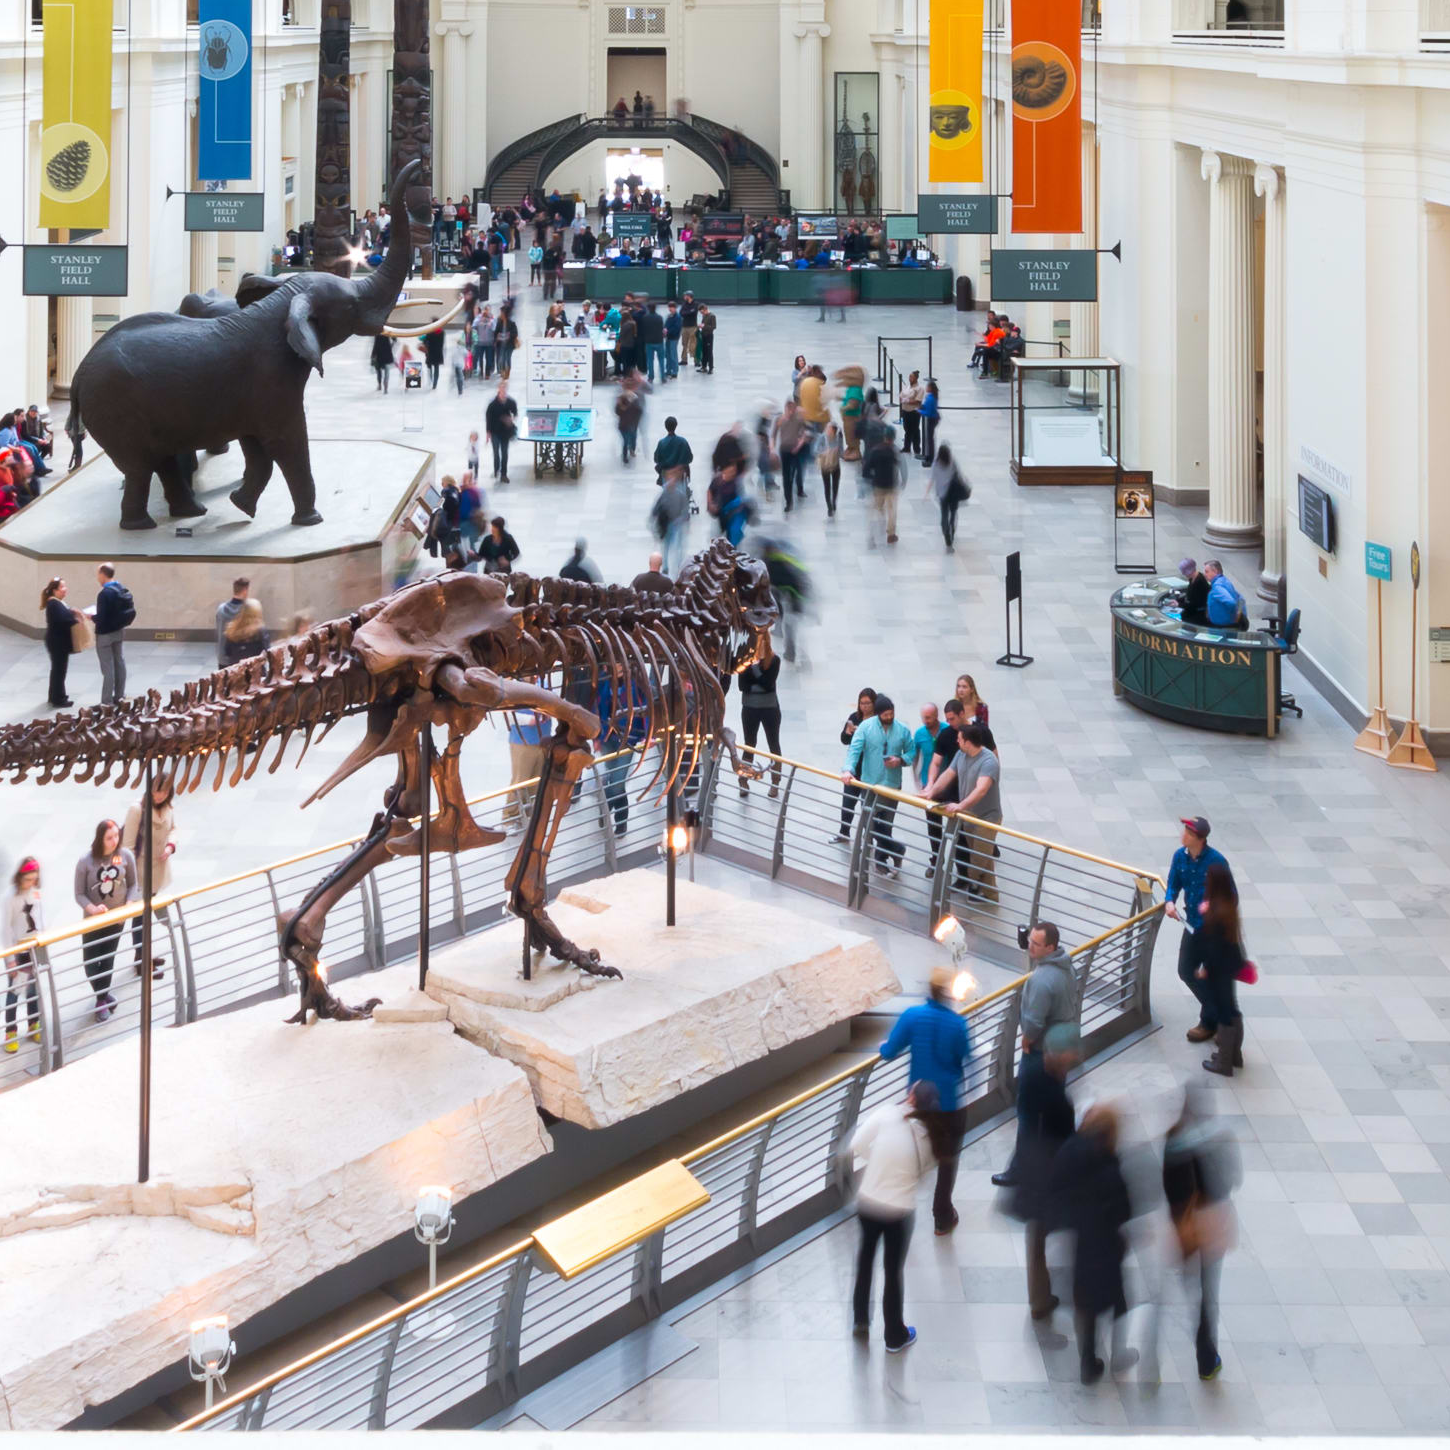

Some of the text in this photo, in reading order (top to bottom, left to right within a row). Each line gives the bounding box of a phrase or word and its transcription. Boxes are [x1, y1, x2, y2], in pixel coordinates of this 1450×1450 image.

[205, 200, 245, 208] STANLEY
[938, 203, 979, 211] STANLEY
[50, 255, 102, 264] STANLEY
[60, 266, 92, 275] FIELD
[1018, 261, 1071, 271] STANLEY
[61, 276, 91, 285] HALL
[1028, 272, 1061, 281] FIELD
[1029, 282, 1060, 291] HALL
[1368, 547, 1386, 561] Free
[1368, 557, 1389, 572] Tours
[1119, 620, 1252, 667] INFORMATION
